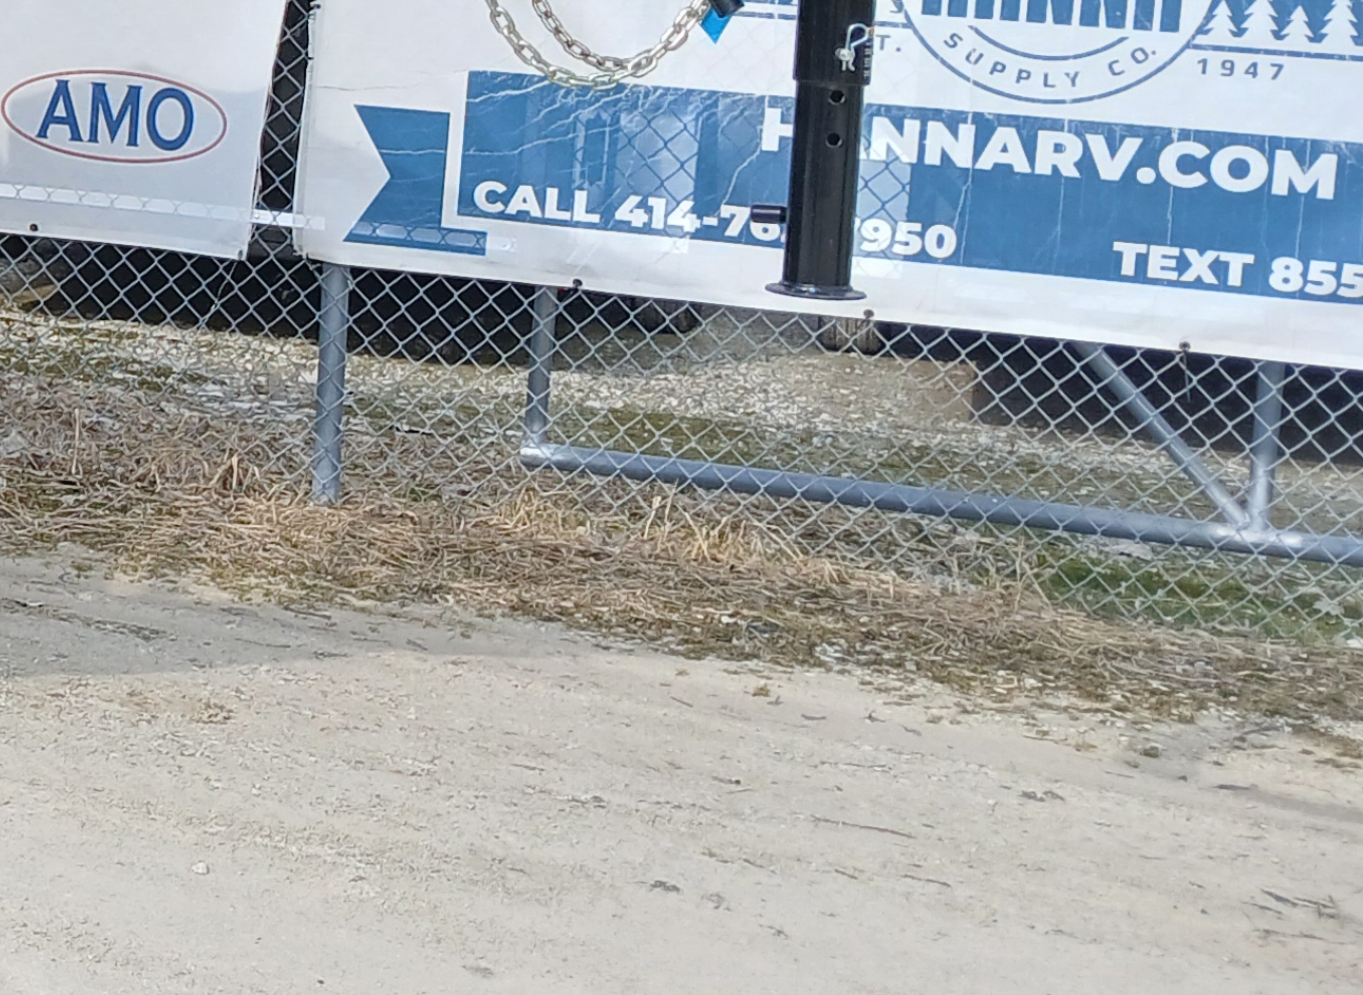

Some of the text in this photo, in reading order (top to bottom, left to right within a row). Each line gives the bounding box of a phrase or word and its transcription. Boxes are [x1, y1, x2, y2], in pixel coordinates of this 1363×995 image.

[943, 33, 1157, 88] SUPPLY CO.
[1196, 57, 1285, 81] 1947
[36, 78, 194, 151] AMO
[761, 107, 1338, 200] HNNARV.COM
[474, 181, 957, 259] CALL 414-76950
[1112, 241, 1255, 287] TEXT
